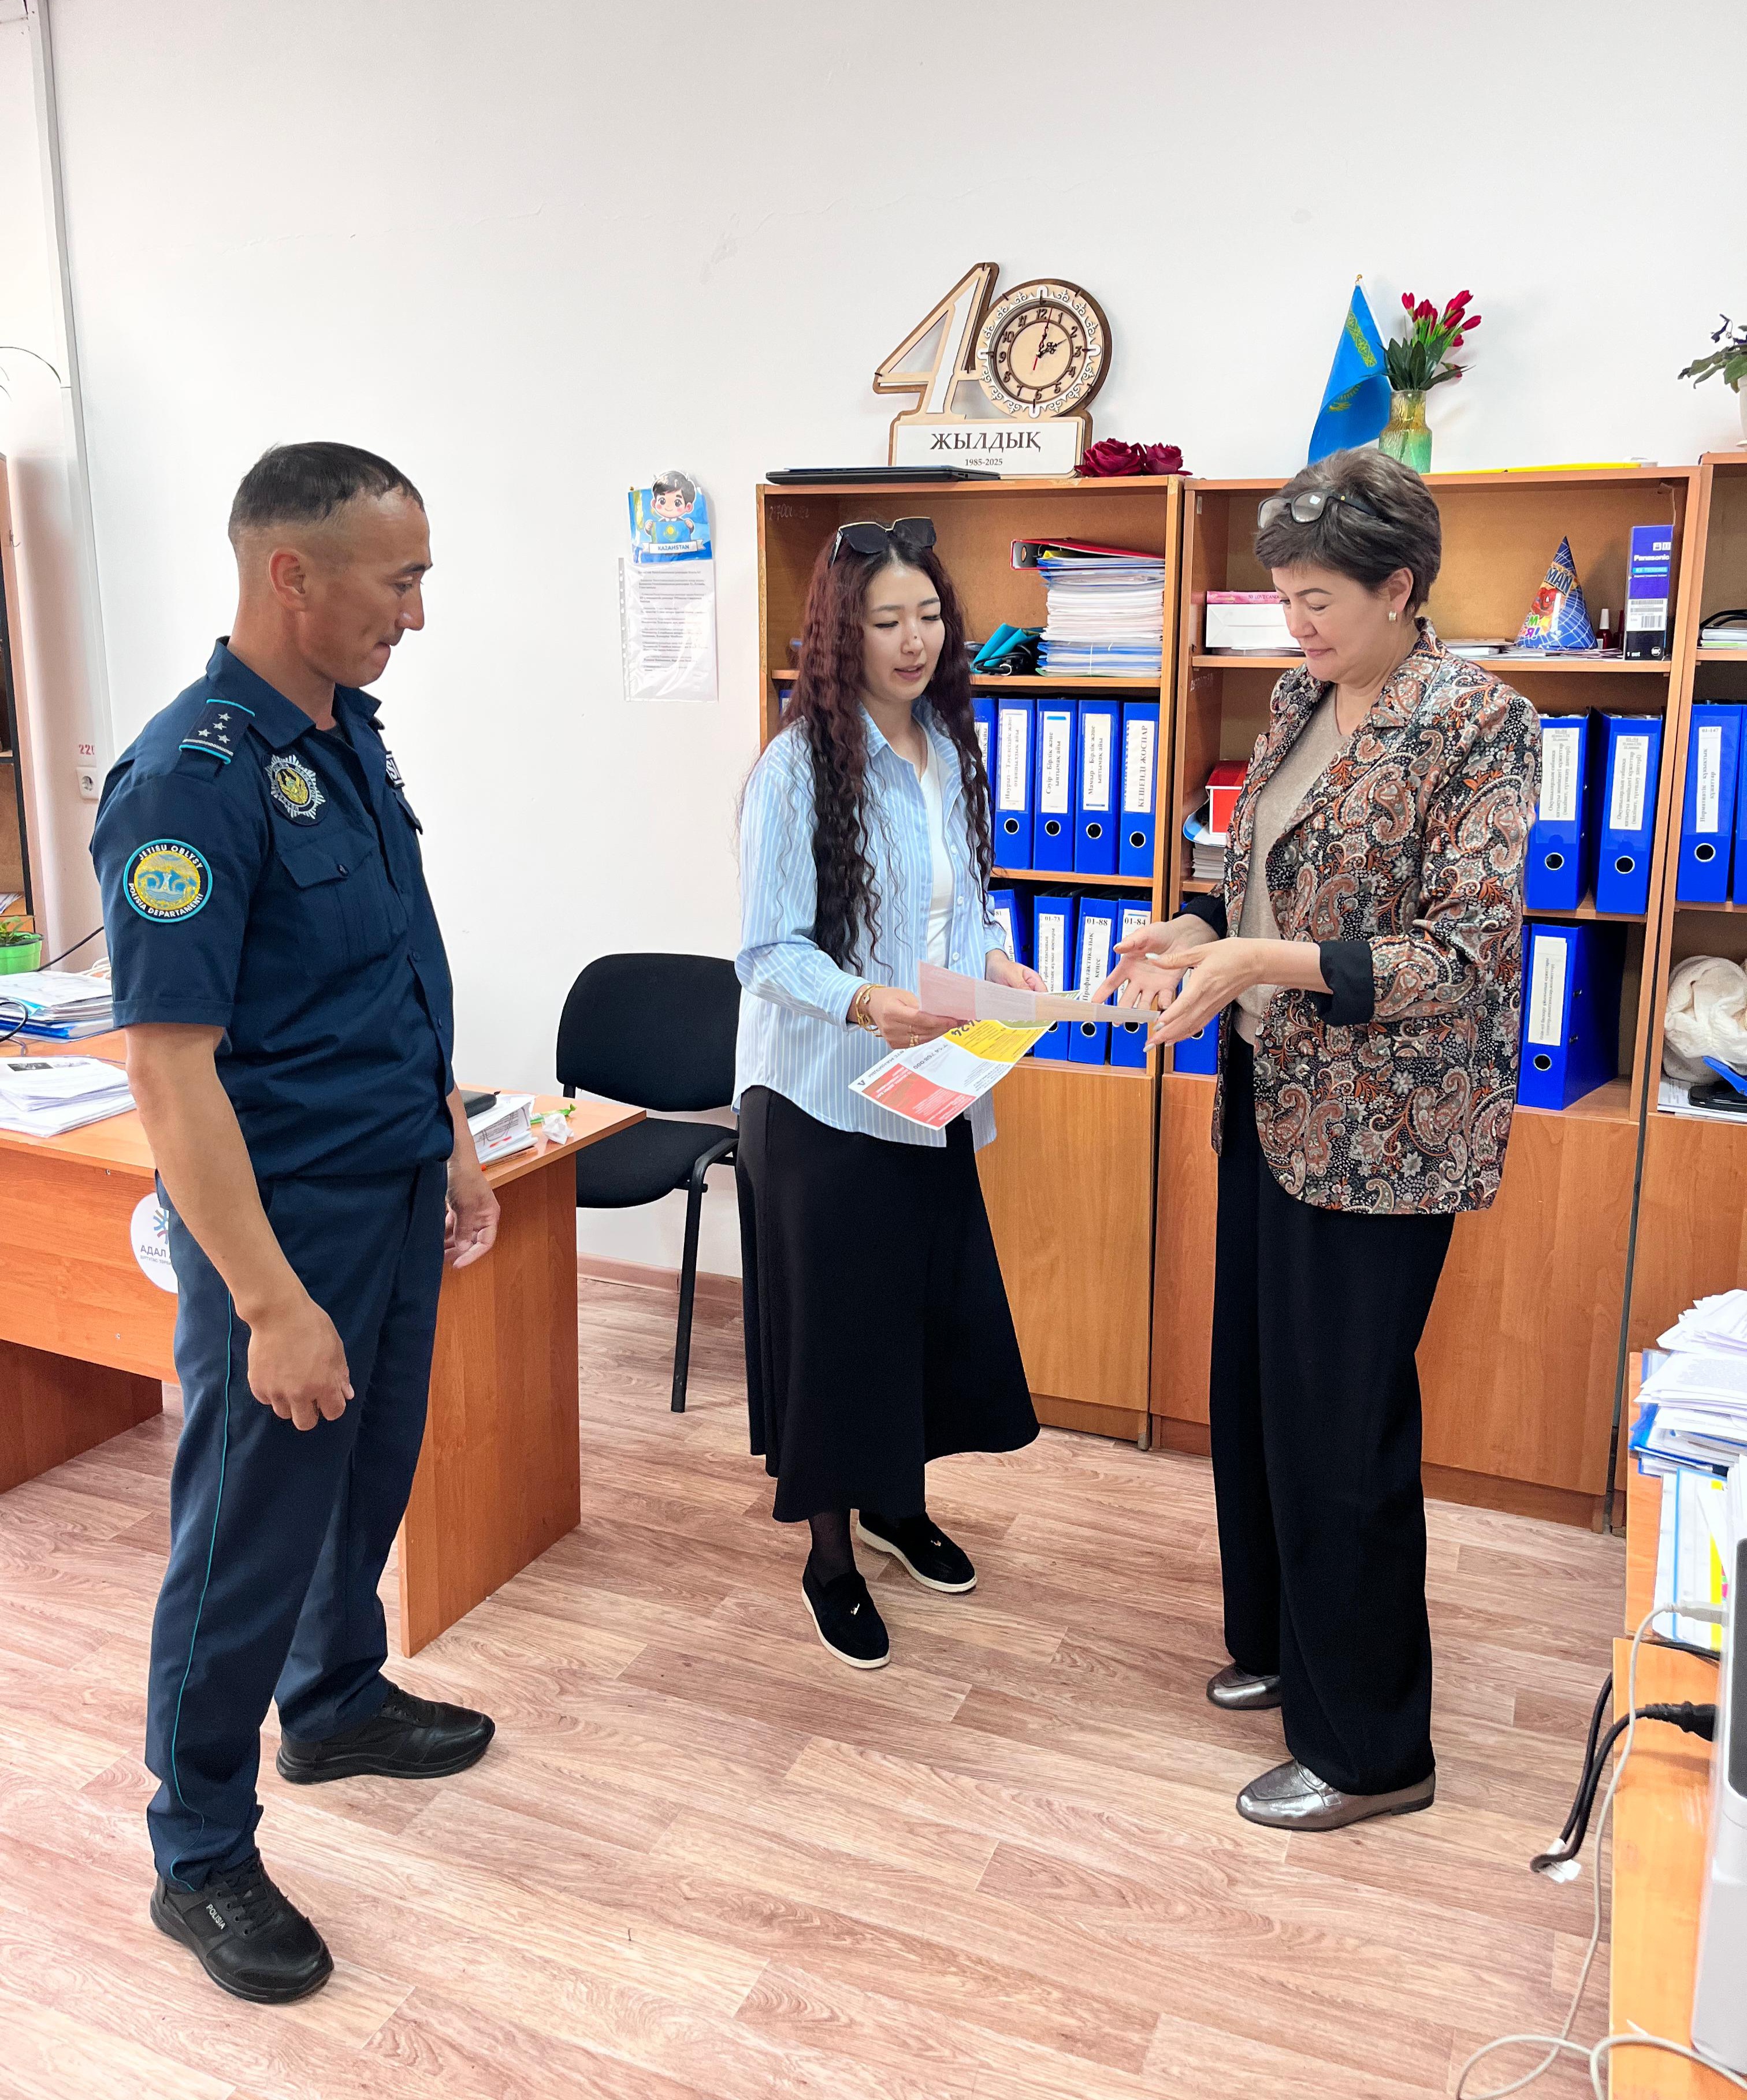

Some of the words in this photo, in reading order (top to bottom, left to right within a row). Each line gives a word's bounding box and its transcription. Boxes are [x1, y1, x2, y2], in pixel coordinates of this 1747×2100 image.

[1036, 308, 1047, 319] 12
[1058, 312, 1064, 324] 1
[1018, 315, 1027, 327] 11
[1002, 331, 1014, 343] 10
[1070, 326, 1077, 338] 2
[999, 352, 1006, 363] 9
[1073, 347, 1082, 357] 3
[1004, 371, 1011, 383] 8
[1069, 367, 1076, 378] 4
[1017, 385, 1023, 396] 7
[1054, 382, 1061, 393] 5
[1035, 389, 1042, 400] 6
[930, 431, 1041, 453] ЖЫЛДЫҚ
[1138, 766, 1146, 807] КЕШЕНДІ
[139, 844, 167, 860] JETISU
[171, 846, 203, 869] OBLYSY
[128, 883, 148, 910] POLISIA
[148, 893, 203, 917] DEPARTAMENTI
[1125, 917, 1146, 925] 01-84
[1082, 933, 1094, 1001] Профилактикалық
[140, 1245, 166, 1257] АДАЛ
[206, 1904, 226, 1930] POLISIA
